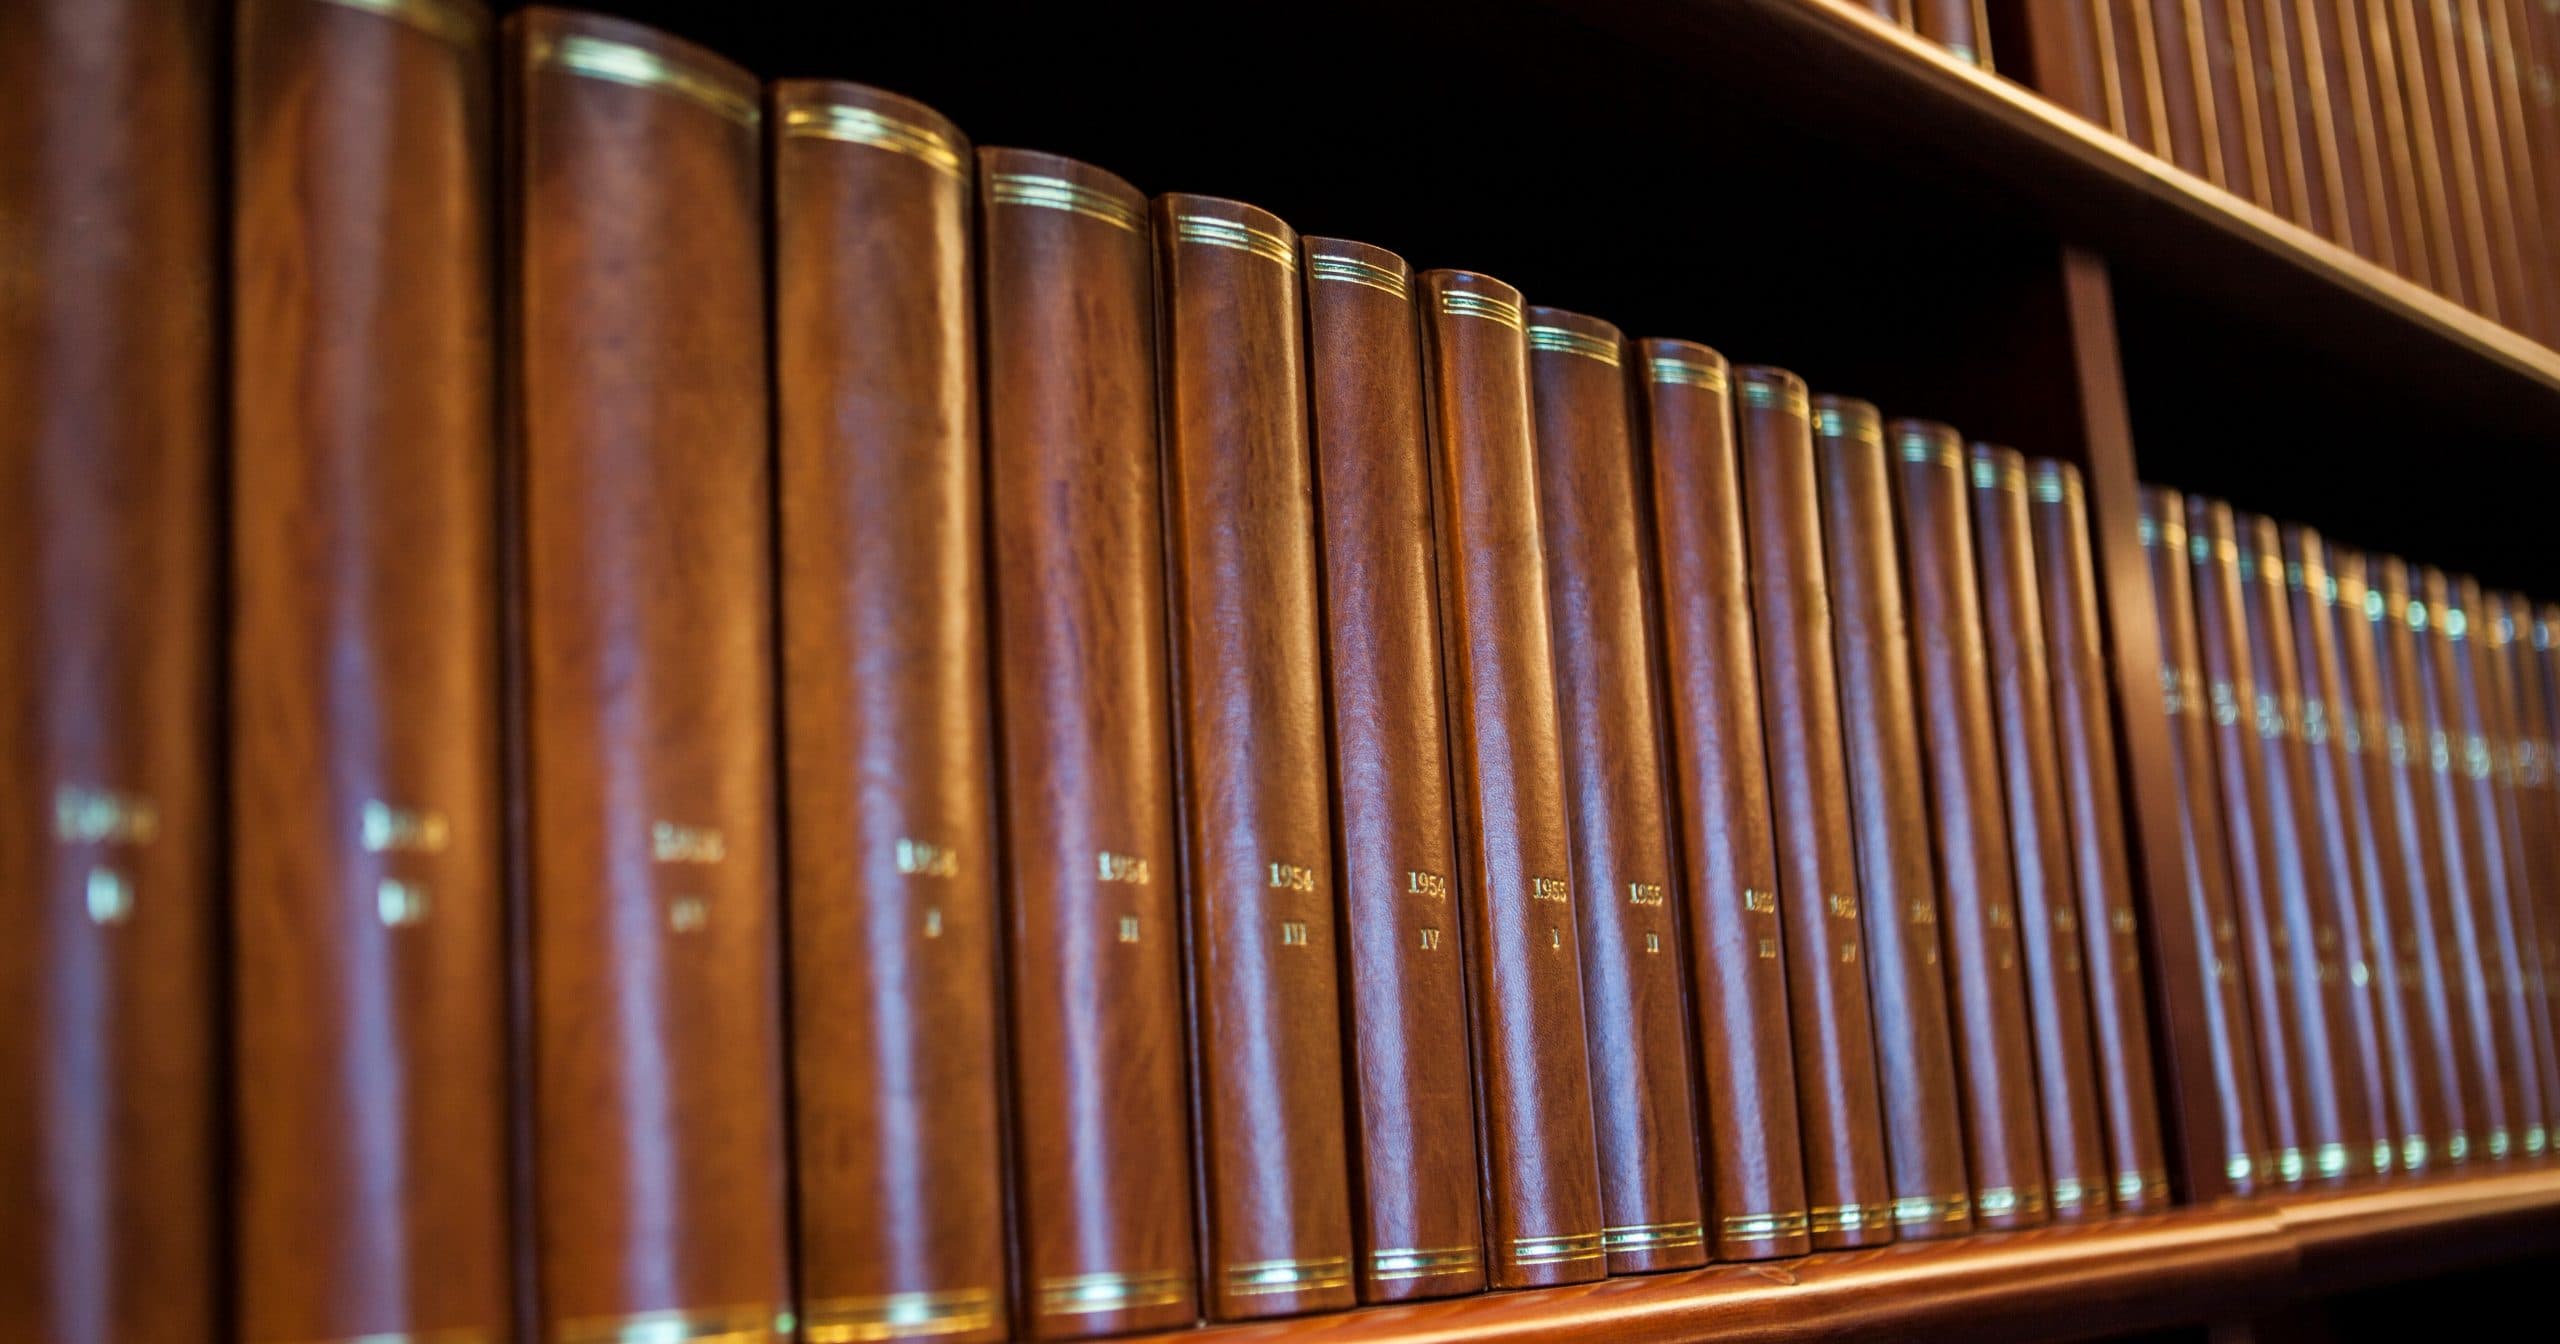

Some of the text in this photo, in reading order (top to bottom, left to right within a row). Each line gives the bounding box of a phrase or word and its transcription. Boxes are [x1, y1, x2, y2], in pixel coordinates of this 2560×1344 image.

[1098, 851, 1150, 885] 1954
[1269, 861, 1314, 892] 1954
[1407, 871, 1446, 902] 1954
[1532, 877, 1567, 904] 1955
[1628, 882, 1663, 906] 1955
[1284, 921, 1308, 946] III
[1420, 928, 1440, 951] IV
[1552, 928, 1561, 949] I
[1646, 932, 1659, 953] II
